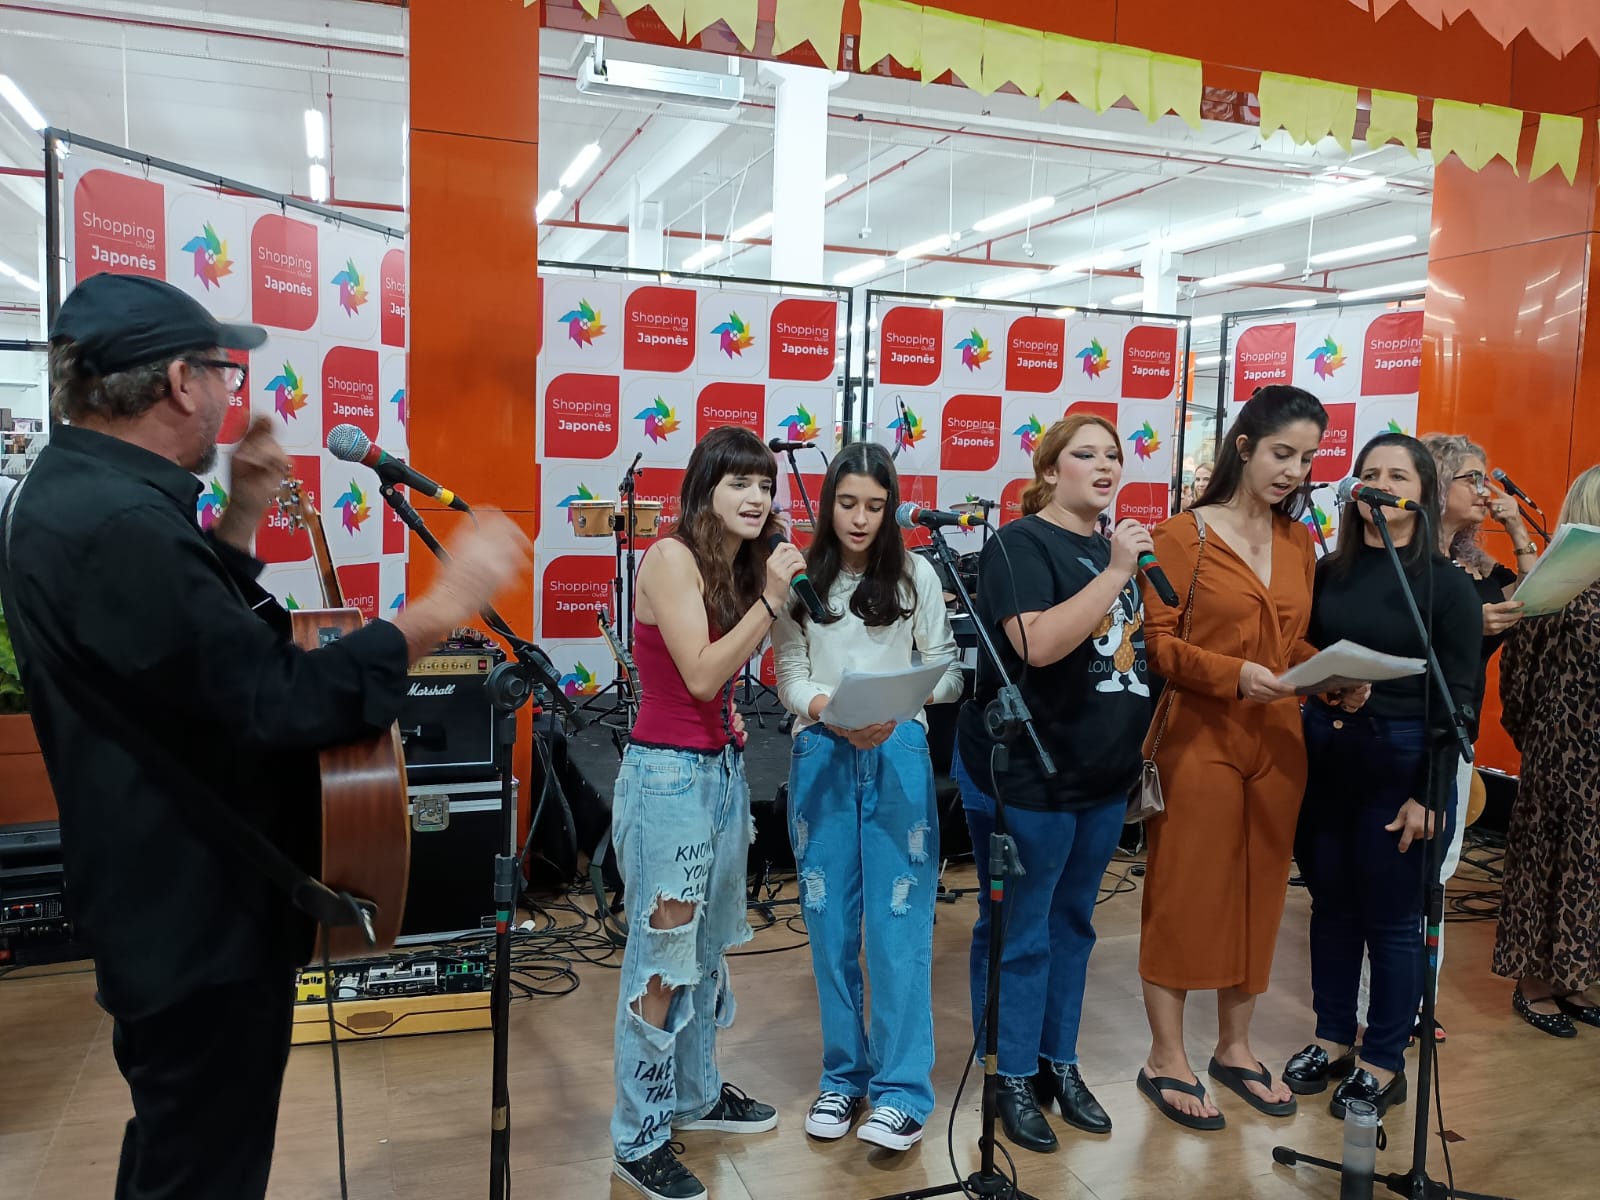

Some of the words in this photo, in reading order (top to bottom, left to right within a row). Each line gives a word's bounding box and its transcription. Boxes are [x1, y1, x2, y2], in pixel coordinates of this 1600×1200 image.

[82, 211, 155, 243] Shopping
[91, 245, 157, 271] Japonês
[258, 246, 312, 273] Shopping
[264, 274, 313, 297] Japonês
[631, 311, 689, 328] Shopping
[776, 322, 829, 337] Shopping
[637, 332, 689, 346] Japonês
[886, 332, 935, 347] Shopping
[1012, 338, 1059, 353] Shopping
[781, 343, 829, 356] Japonês
[1128, 347, 1171, 361] Shopping
[1239, 350, 1287, 362] Shopping
[891, 352, 935, 364] Japonês
[1016, 356, 1058, 370] Japonês
[1132, 365, 1170, 377] Japonês
[1243, 368, 1287, 381] Japonês
[327, 376, 374, 395] Shopping
[332, 402, 375, 417] Japonês
[552, 398, 611, 414] Shopping
[703, 406, 758, 421] Shopping
[558, 419, 612, 433] Japonês
[947, 416, 995, 430] Shopping
[1322, 427, 1348, 440] ping
[951, 435, 995, 448] Japonês
[1120, 503, 1163, 516] Shopping
[267, 514, 289, 530] Jap
[550, 580, 608, 593] Shopping
[555, 600, 609, 613] Japonês
[406, 682, 457, 696] Marshall
[634, 1055, 673, 1082] TAKE
[645, 1079, 674, 1104] THE
